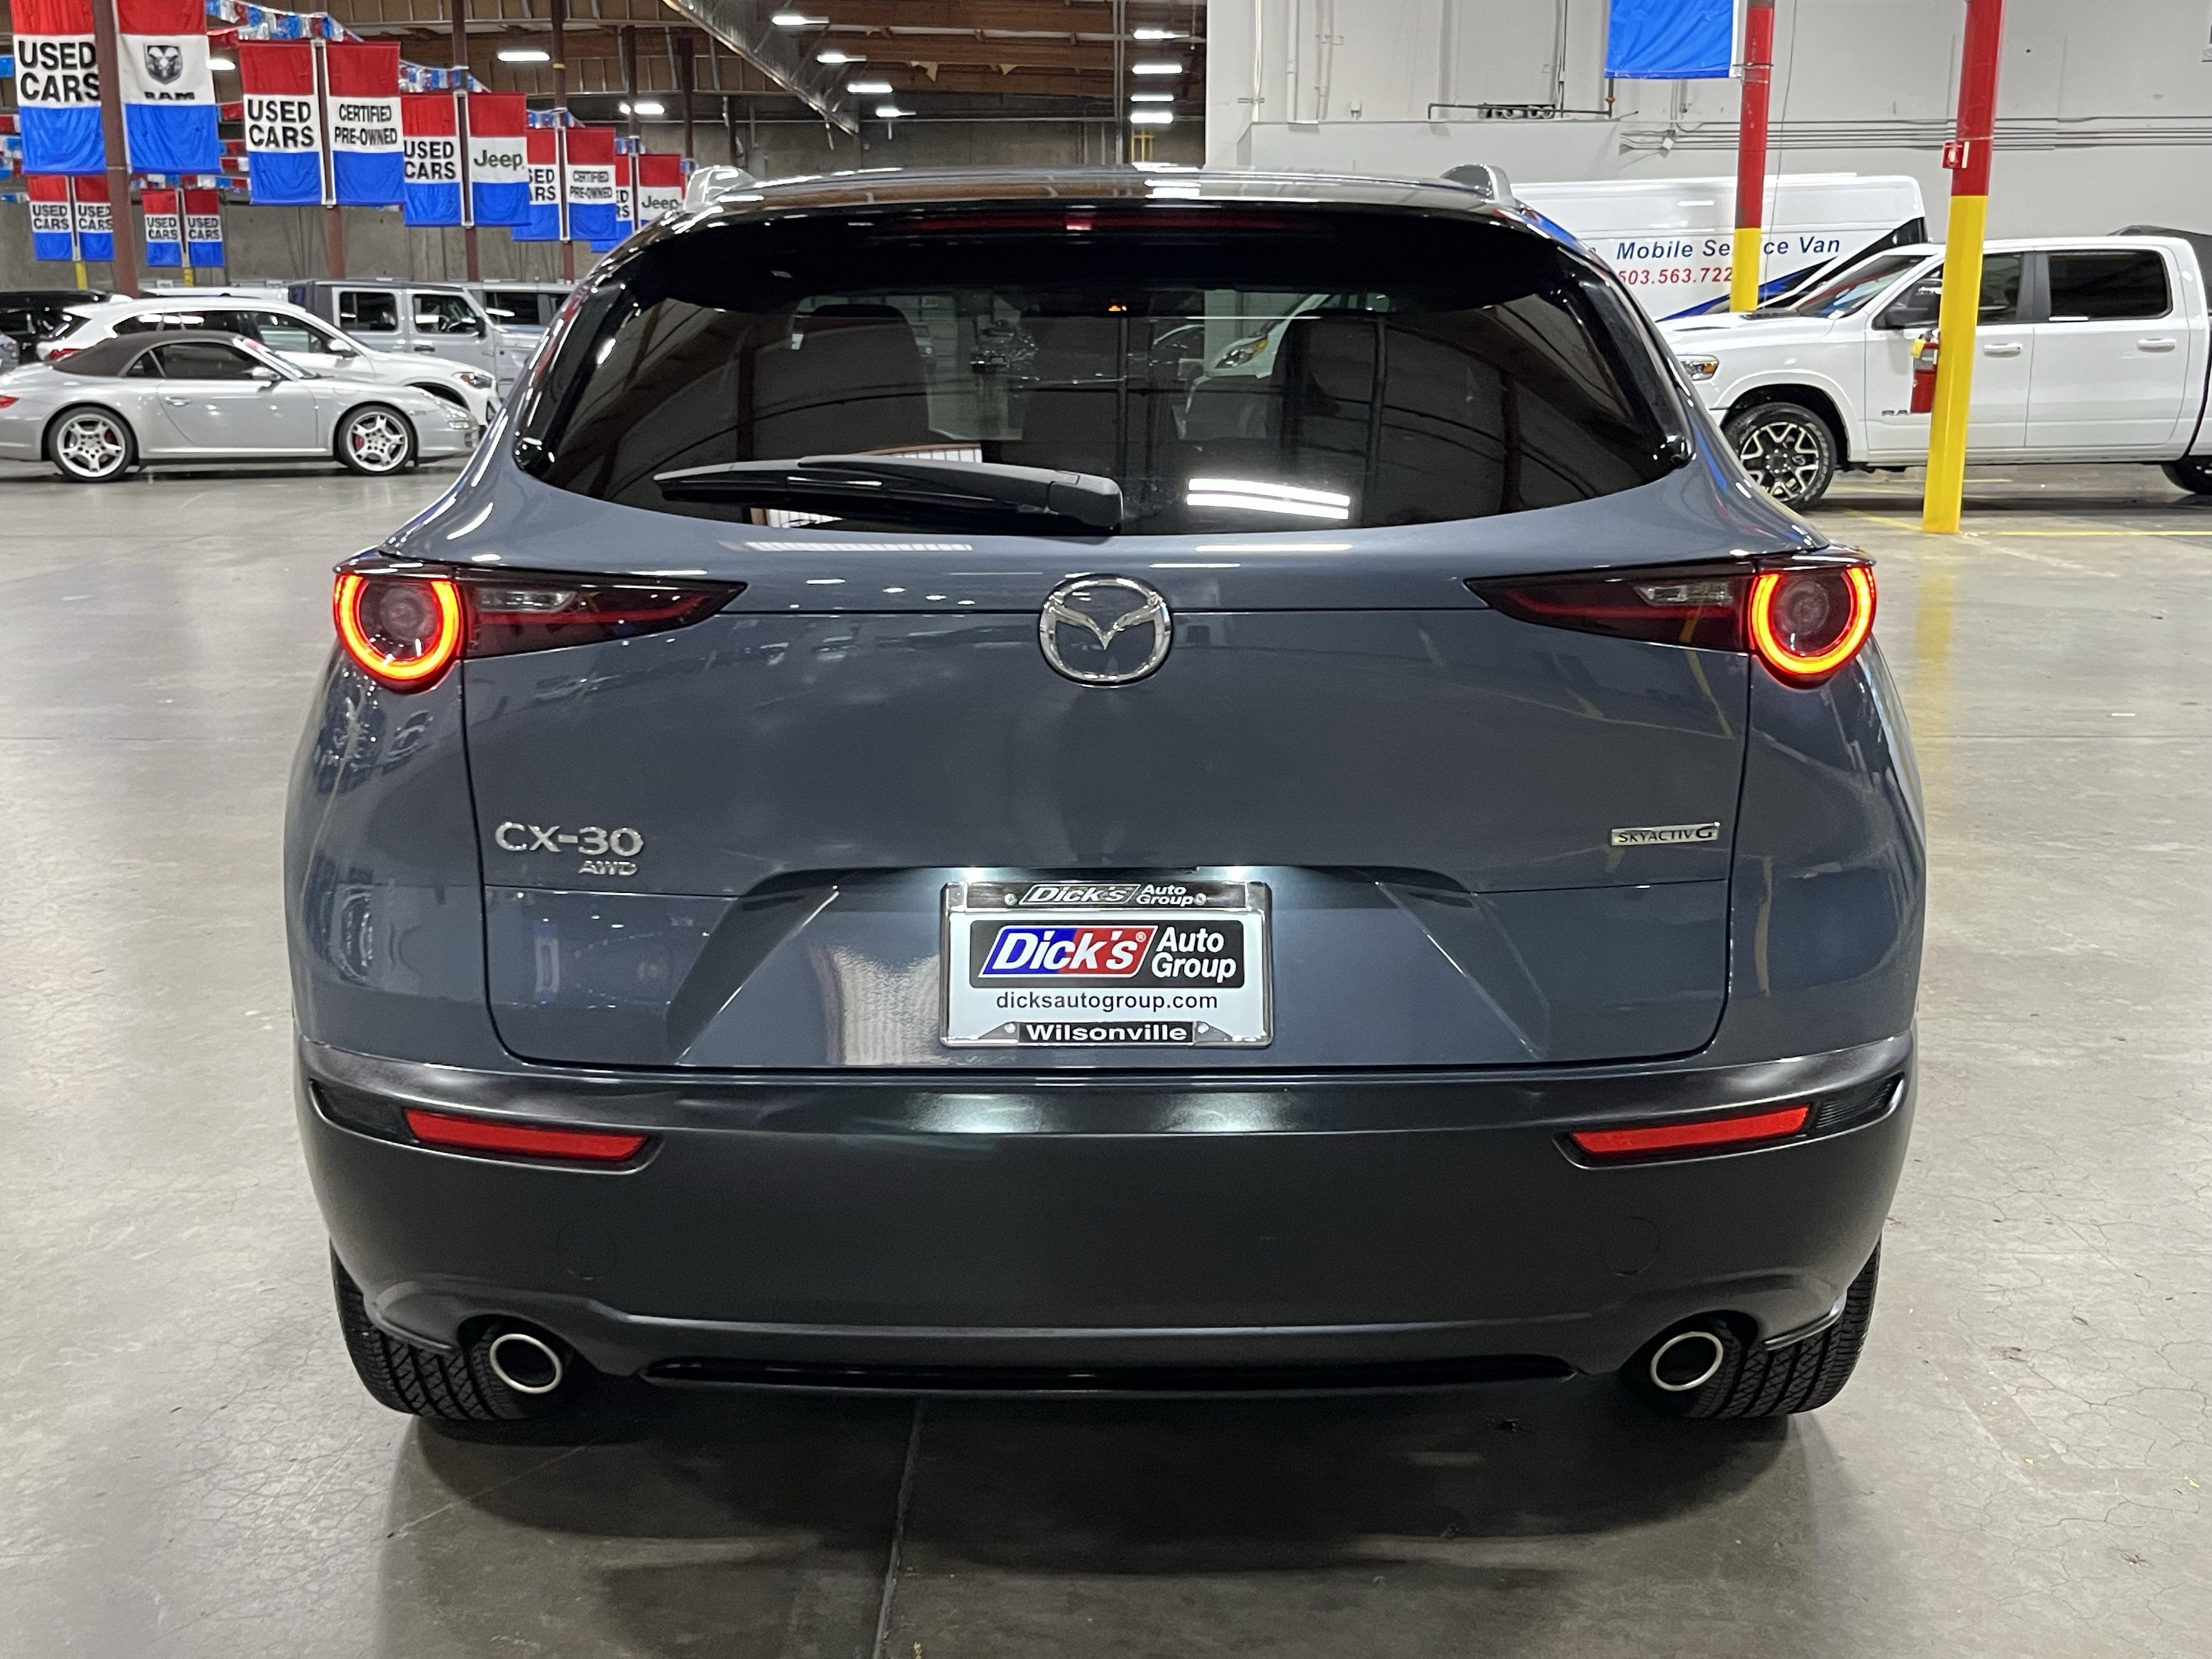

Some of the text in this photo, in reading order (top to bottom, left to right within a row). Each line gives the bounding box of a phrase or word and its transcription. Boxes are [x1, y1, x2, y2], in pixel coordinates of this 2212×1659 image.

[19, 41, 96, 70] USED
[20, 72, 99, 102] CARS
[145, 92, 195, 100] RAM
[248, 99, 311, 123] USED
[339, 104, 392, 122] CERTIFIED
[249, 125, 314, 148] CARS
[335, 126, 397, 145] PRE-OWNED
[404, 140, 454, 159] USED
[473, 150, 523, 171] Jeep
[404, 161, 456, 180] CARS
[33, 204, 67, 217] USED
[78, 204, 111, 218] USED
[33, 218, 69, 230] CARS
[78, 218, 112, 230] CARS
[146, 217, 177, 228] USED
[188, 217, 218, 228] USED
[148, 229, 178, 240] CARS
[188, 229, 220, 240] CARS
[1616, 240, 1694, 261] Mobile
[1702, 238, 1789, 257] Sece
[1799, 236, 1841, 255] Van
[1619, 267, 1733, 285] 503.563.722
[495, 821, 645, 857] CX-30
[1028, 887, 1128, 903] Dick's
[1142, 884, 1187, 895] Auto
[1136, 894, 1194, 907] Group
[1156, 927, 1225, 953] Auto
[1152, 952, 1237, 983] Group
[996, 992, 1218, 1013] dicksautogroup.com
[1026, 1024, 1188, 1041] Wilsonville
